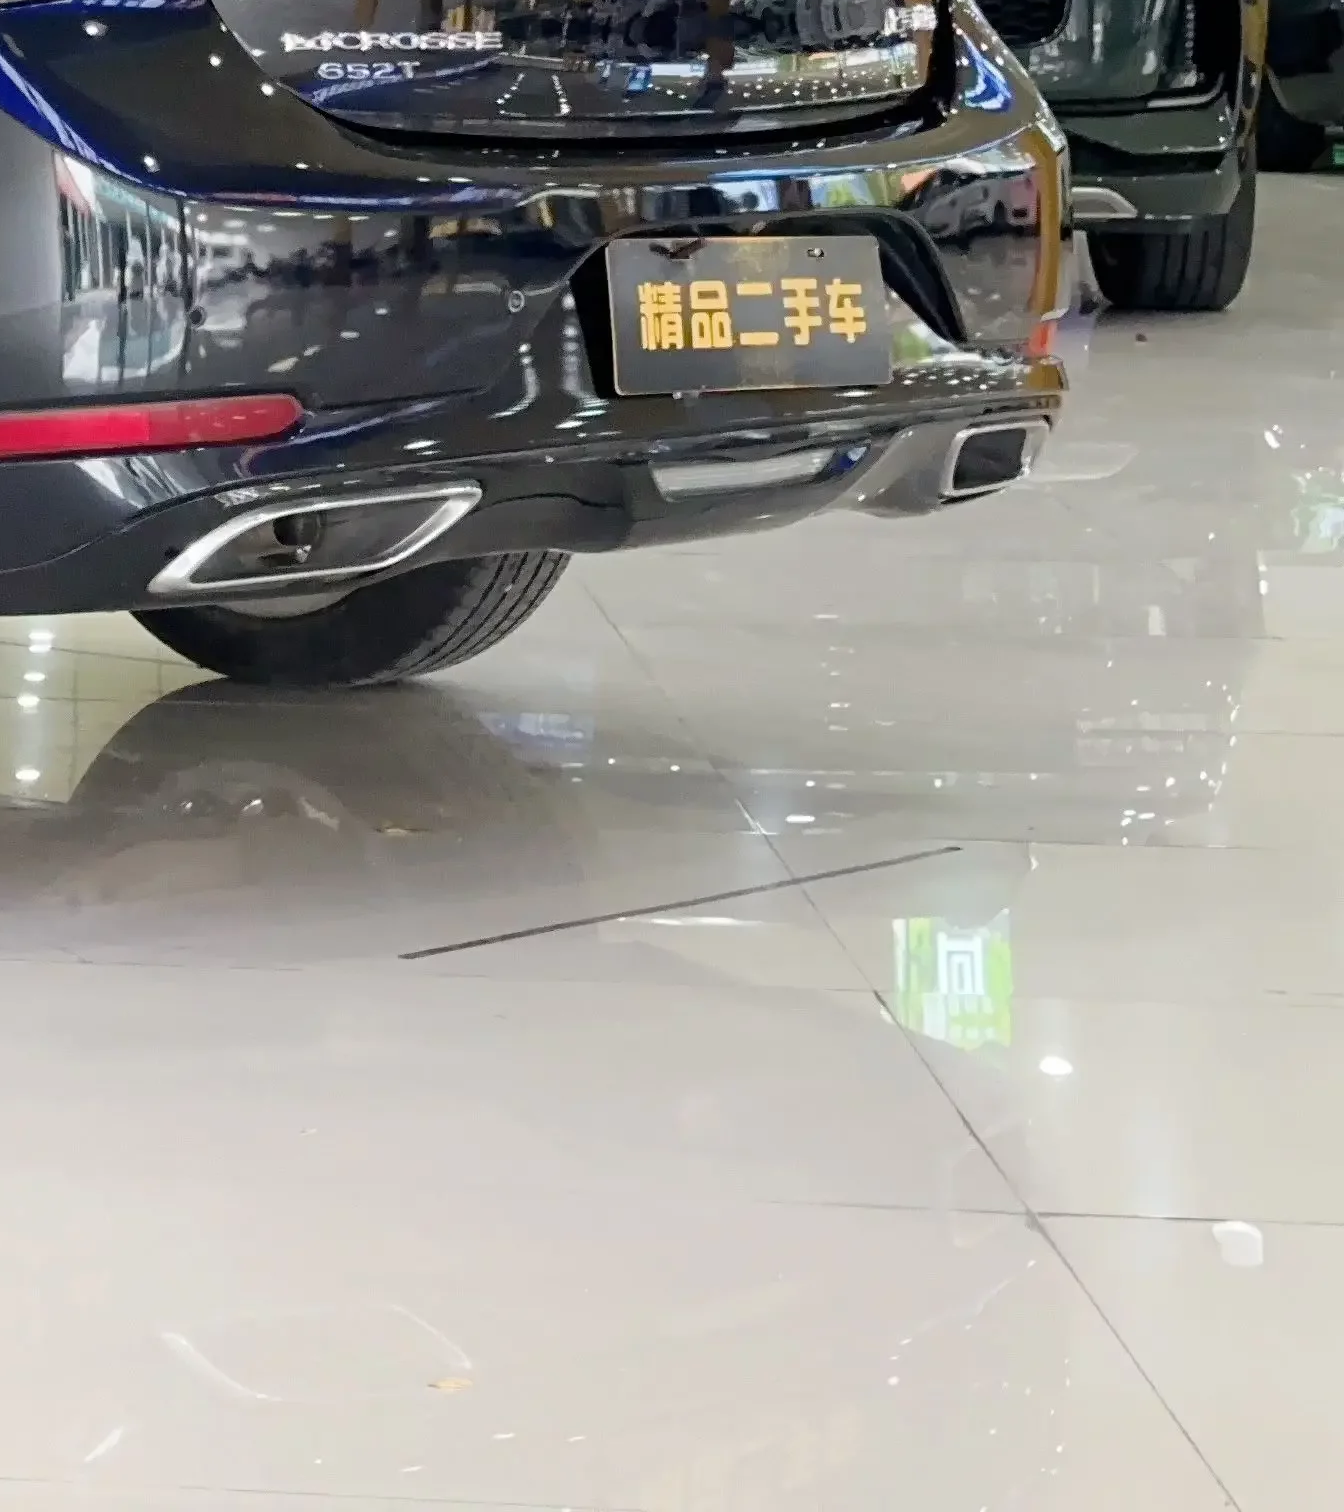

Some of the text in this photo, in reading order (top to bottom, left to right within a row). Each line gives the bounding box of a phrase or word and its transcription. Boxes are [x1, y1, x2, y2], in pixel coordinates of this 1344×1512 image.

[318, 61, 420, 80] 652T
[638, 278, 867, 351] 精品二手车
